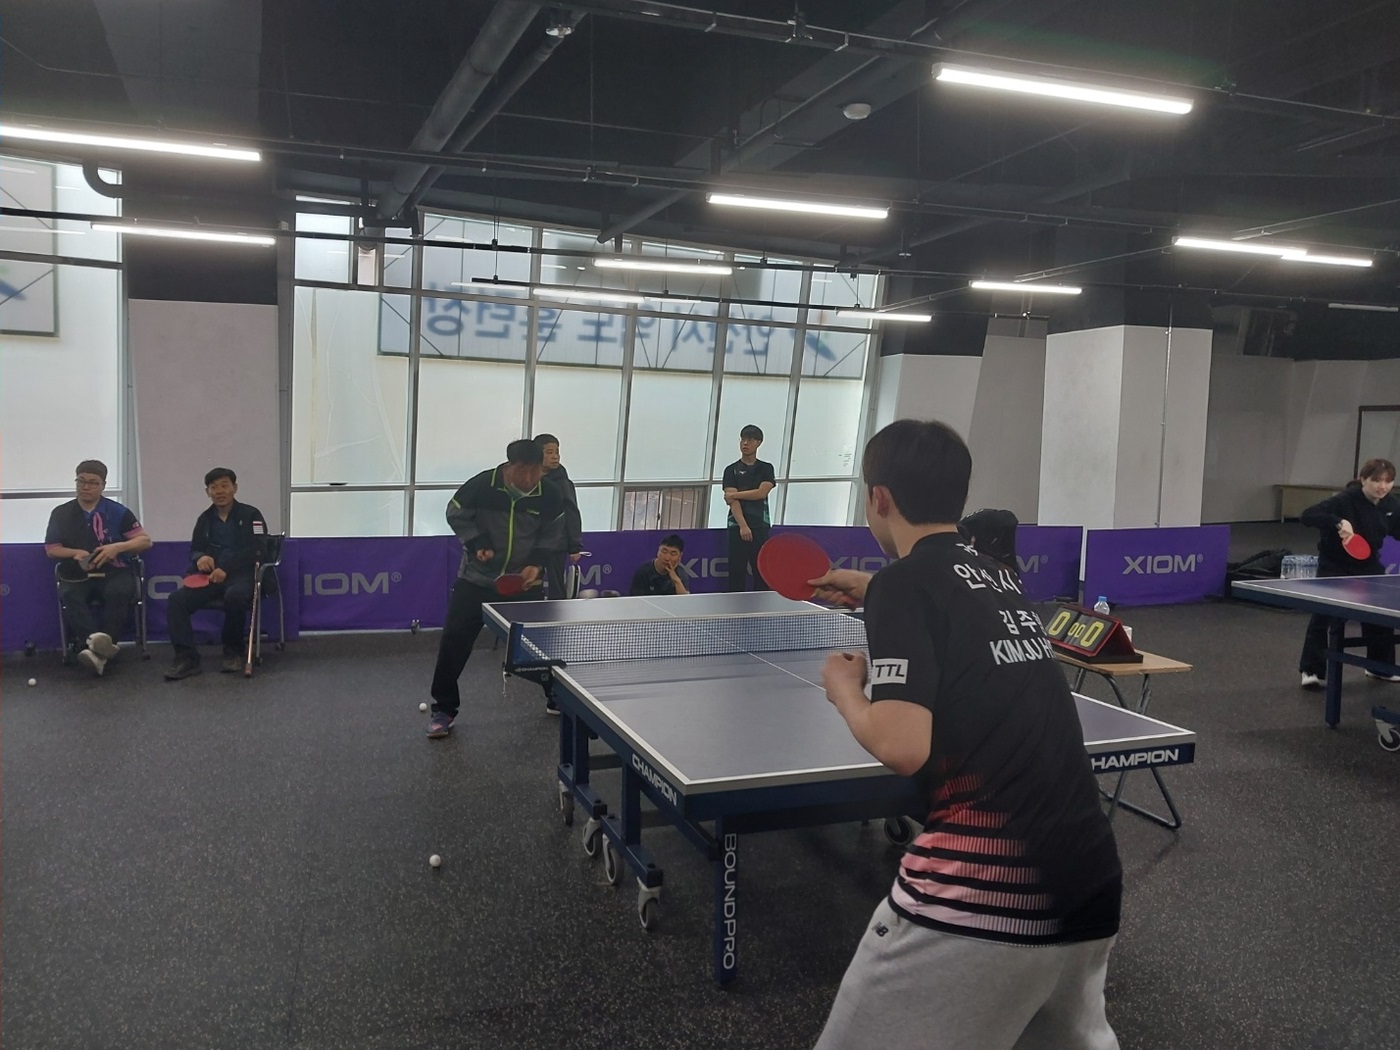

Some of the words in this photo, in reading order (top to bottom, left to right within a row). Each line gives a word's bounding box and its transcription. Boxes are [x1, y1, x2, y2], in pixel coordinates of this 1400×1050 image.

[1122, 554, 1196, 574] XIOM
[304, 572, 389, 596] IOM
[953, 563, 1022, 594] 안산시
[875, 664, 905, 678] TTL
[1091, 749, 1179, 770] HAMPION
[632, 753, 677, 806] CHAMPION
[723, 833, 737, 969] BOUNDPRO
